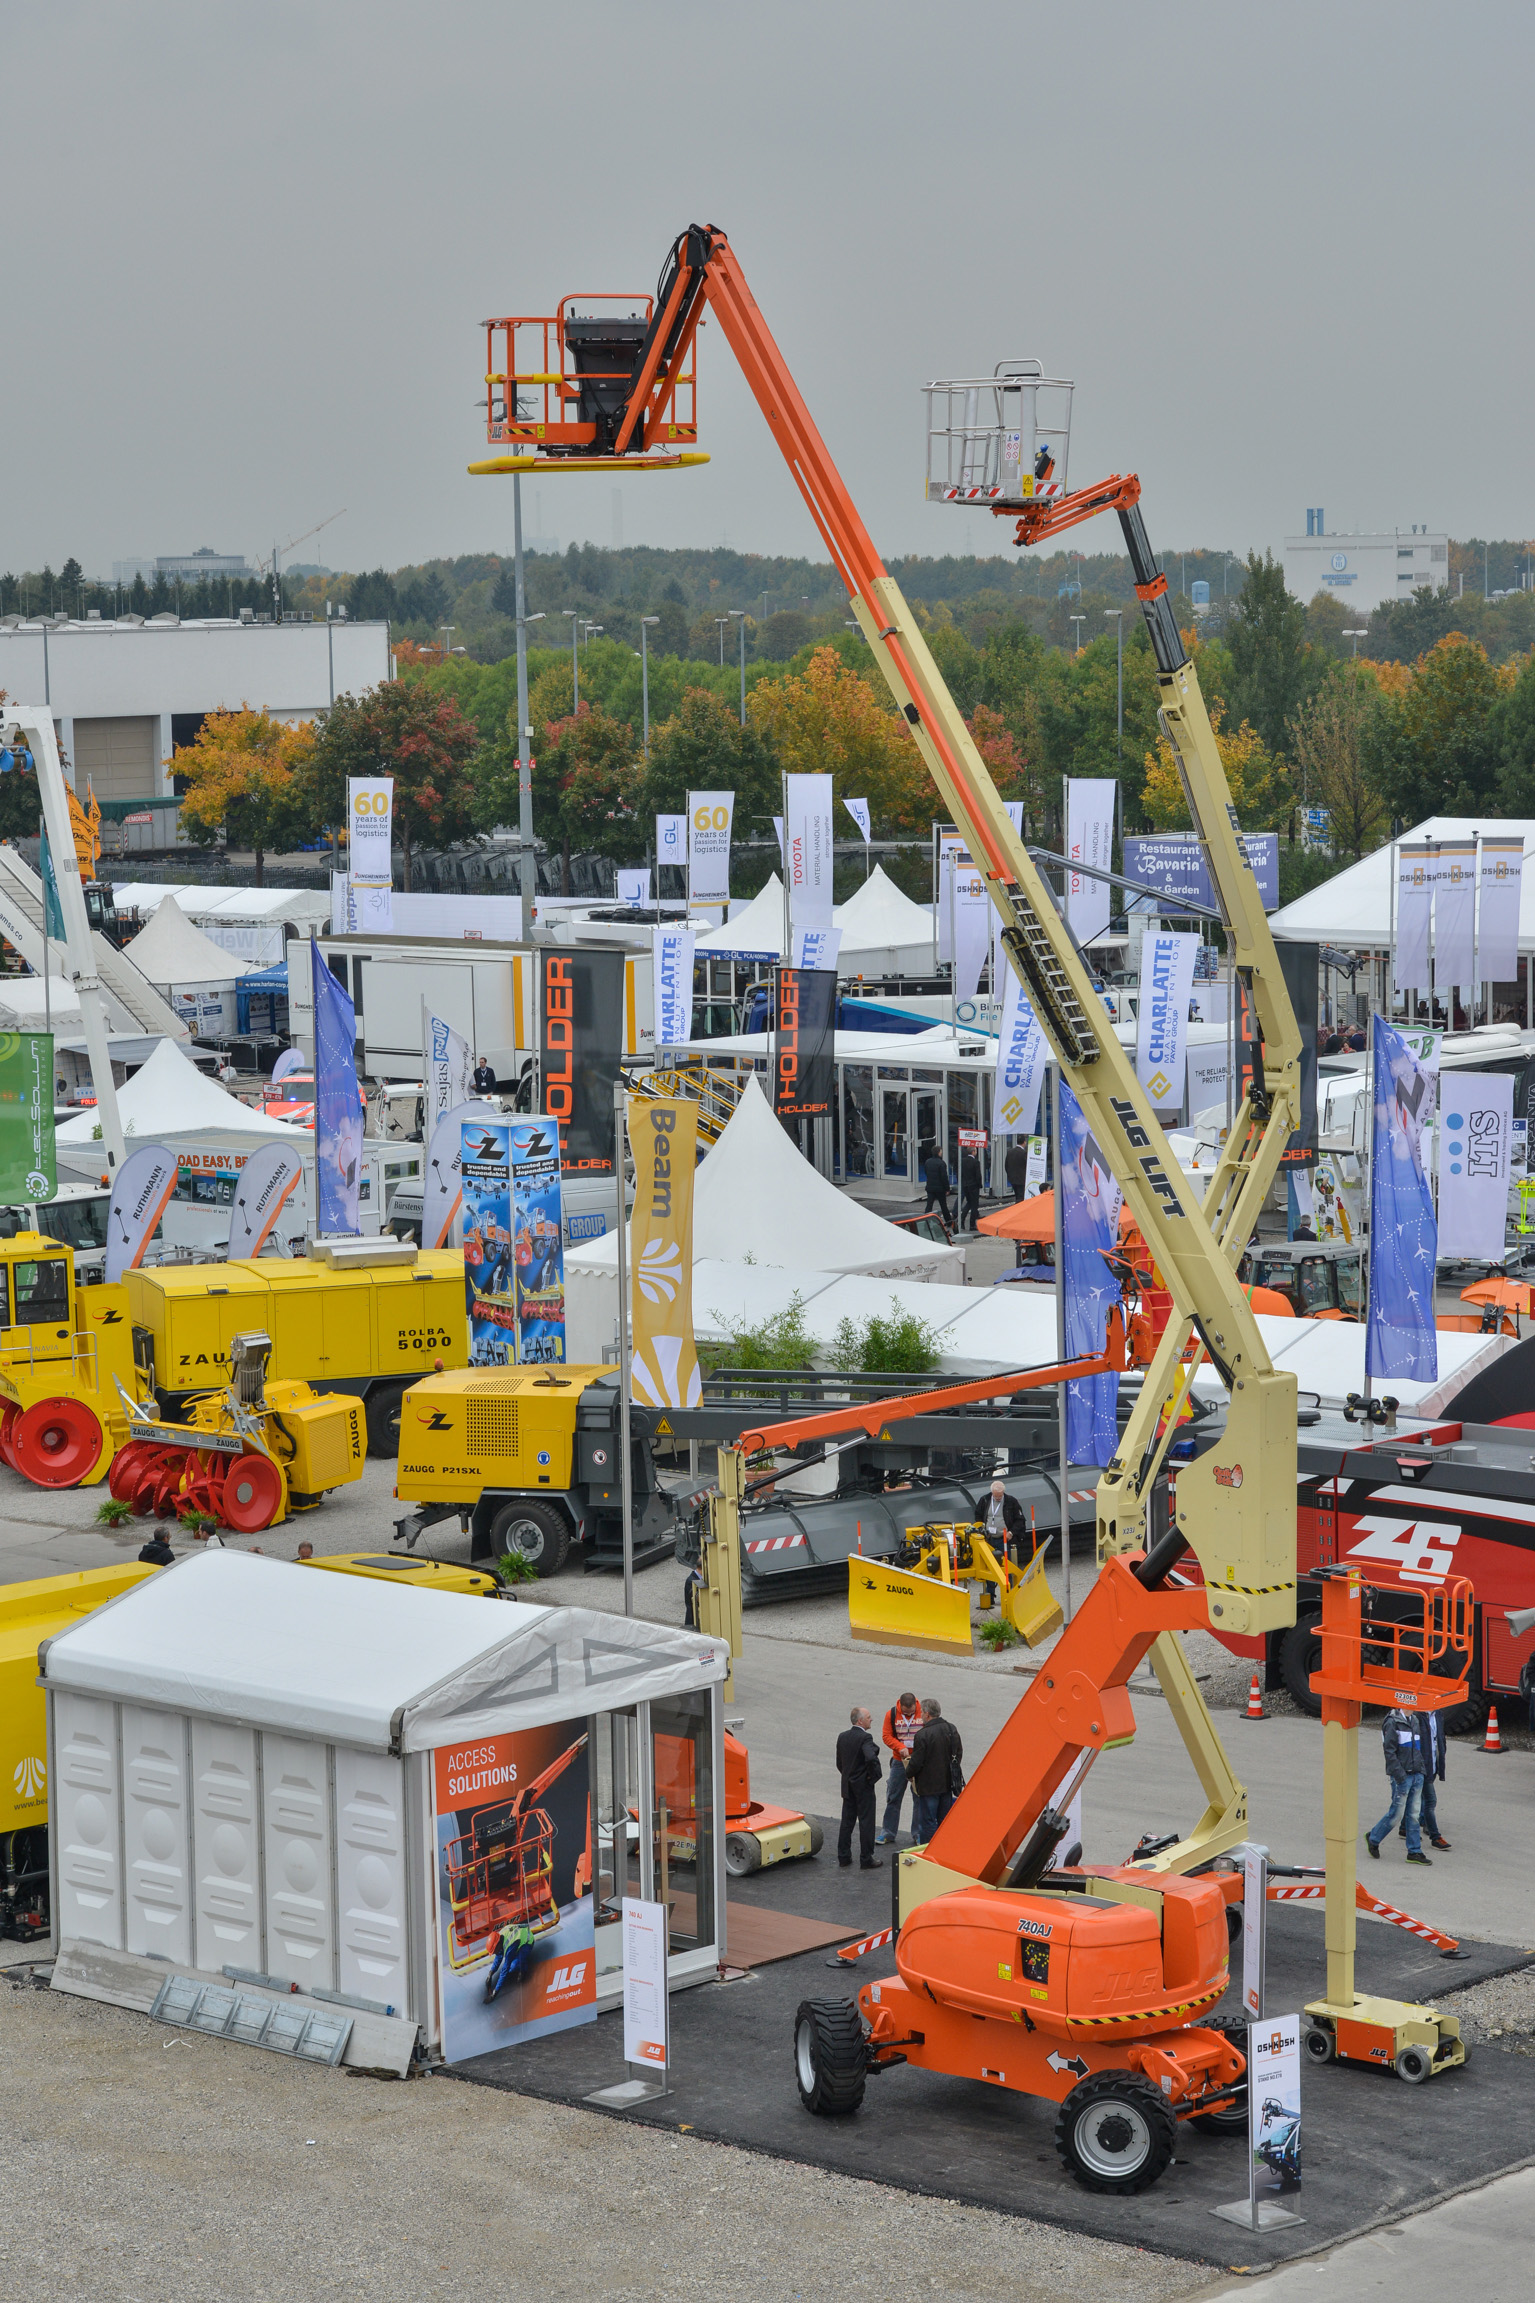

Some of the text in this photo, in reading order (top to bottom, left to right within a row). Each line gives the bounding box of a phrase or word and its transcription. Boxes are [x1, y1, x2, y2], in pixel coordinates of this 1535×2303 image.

[491, 425, 503, 439] JLG
[354, 792, 388, 815] 60
[694, 806, 729, 831] 60
[355, 830, 388, 838] logistics
[719, 830, 728, 838] of
[694, 846, 728, 854] logistics
[1139, 843, 1200, 855] Restaurant
[1235, 836, 1252, 872] LIFT
[793, 837, 803, 886] TOYOTA
[1091, 821, 1100, 894] MATAL HANDLING
[1071, 844, 1080, 895] TOYTA
[1437, 871, 1474, 880] OSHKOSH
[1482, 868, 1521, 876] OSHKOSH
[1165, 873, 1173, 882] &
[1400, 874, 1437, 882] OSHKOSH
[957, 885, 988, 893] OSHKOS
[1164, 885, 1200, 895] Garden
[1148, 939, 1174, 1064] CHARLATTE
[1164, 939, 1181, 1064] MANUTENTION
[779, 969, 799, 1099] HOLDER
[1004, 987, 1036, 1089] CHARLAT
[1169, 1009, 1179, 1064] FAYAT GROUP
[777, 1103, 828, 1116] HOLDER
[1467, 1109, 1500, 1178] ITS
[178, 1154, 200, 1167] OAD
[203, 1155, 232, 1170] EASY,
[1108, 1096, 1187, 1216] JLG LIFT
[516, 1161, 539, 1170] trusted
[516, 1165, 555, 1176] dependable
[560, 1158, 612, 1171] OLDER
[650, 1109, 676, 1218] Beam
[467, 1170, 507, 1178] dependable
[133, 1165, 162, 1220] RUTHMANN
[255, 1162, 288, 1213] RUTHMANN
[187, 1205, 212, 1213] professionals
[570, 1216, 605, 1238] GROUP
[398, 1328, 446, 1337] ROLBA
[398, 1336, 452, 1350] 5000
[179, 1353, 227, 1366] ZAU
[132, 1426, 156, 1438] ZAUGG
[350, 1409, 361, 1459] ZAUGG
[215, 1438, 240, 1449] ZAUGG
[403, 1465, 482, 1475] ZAUGG P21SXL
[886, 1584, 914, 1596] ZAUGG
[1395, 1692, 1417, 1701] 1230ES
[447, 1745, 496, 1773] ACCESS
[448, 1764, 518, 1796] SOLUTIONS
[1017, 1919, 1053, 1938] 740AJ
[546, 1962, 587, 1994] JLG
[1092, 1967, 1158, 2003] JLG
[1257, 2037, 1295, 2053] OSHKOSH
[1369, 2047, 1387, 2058] JLG
